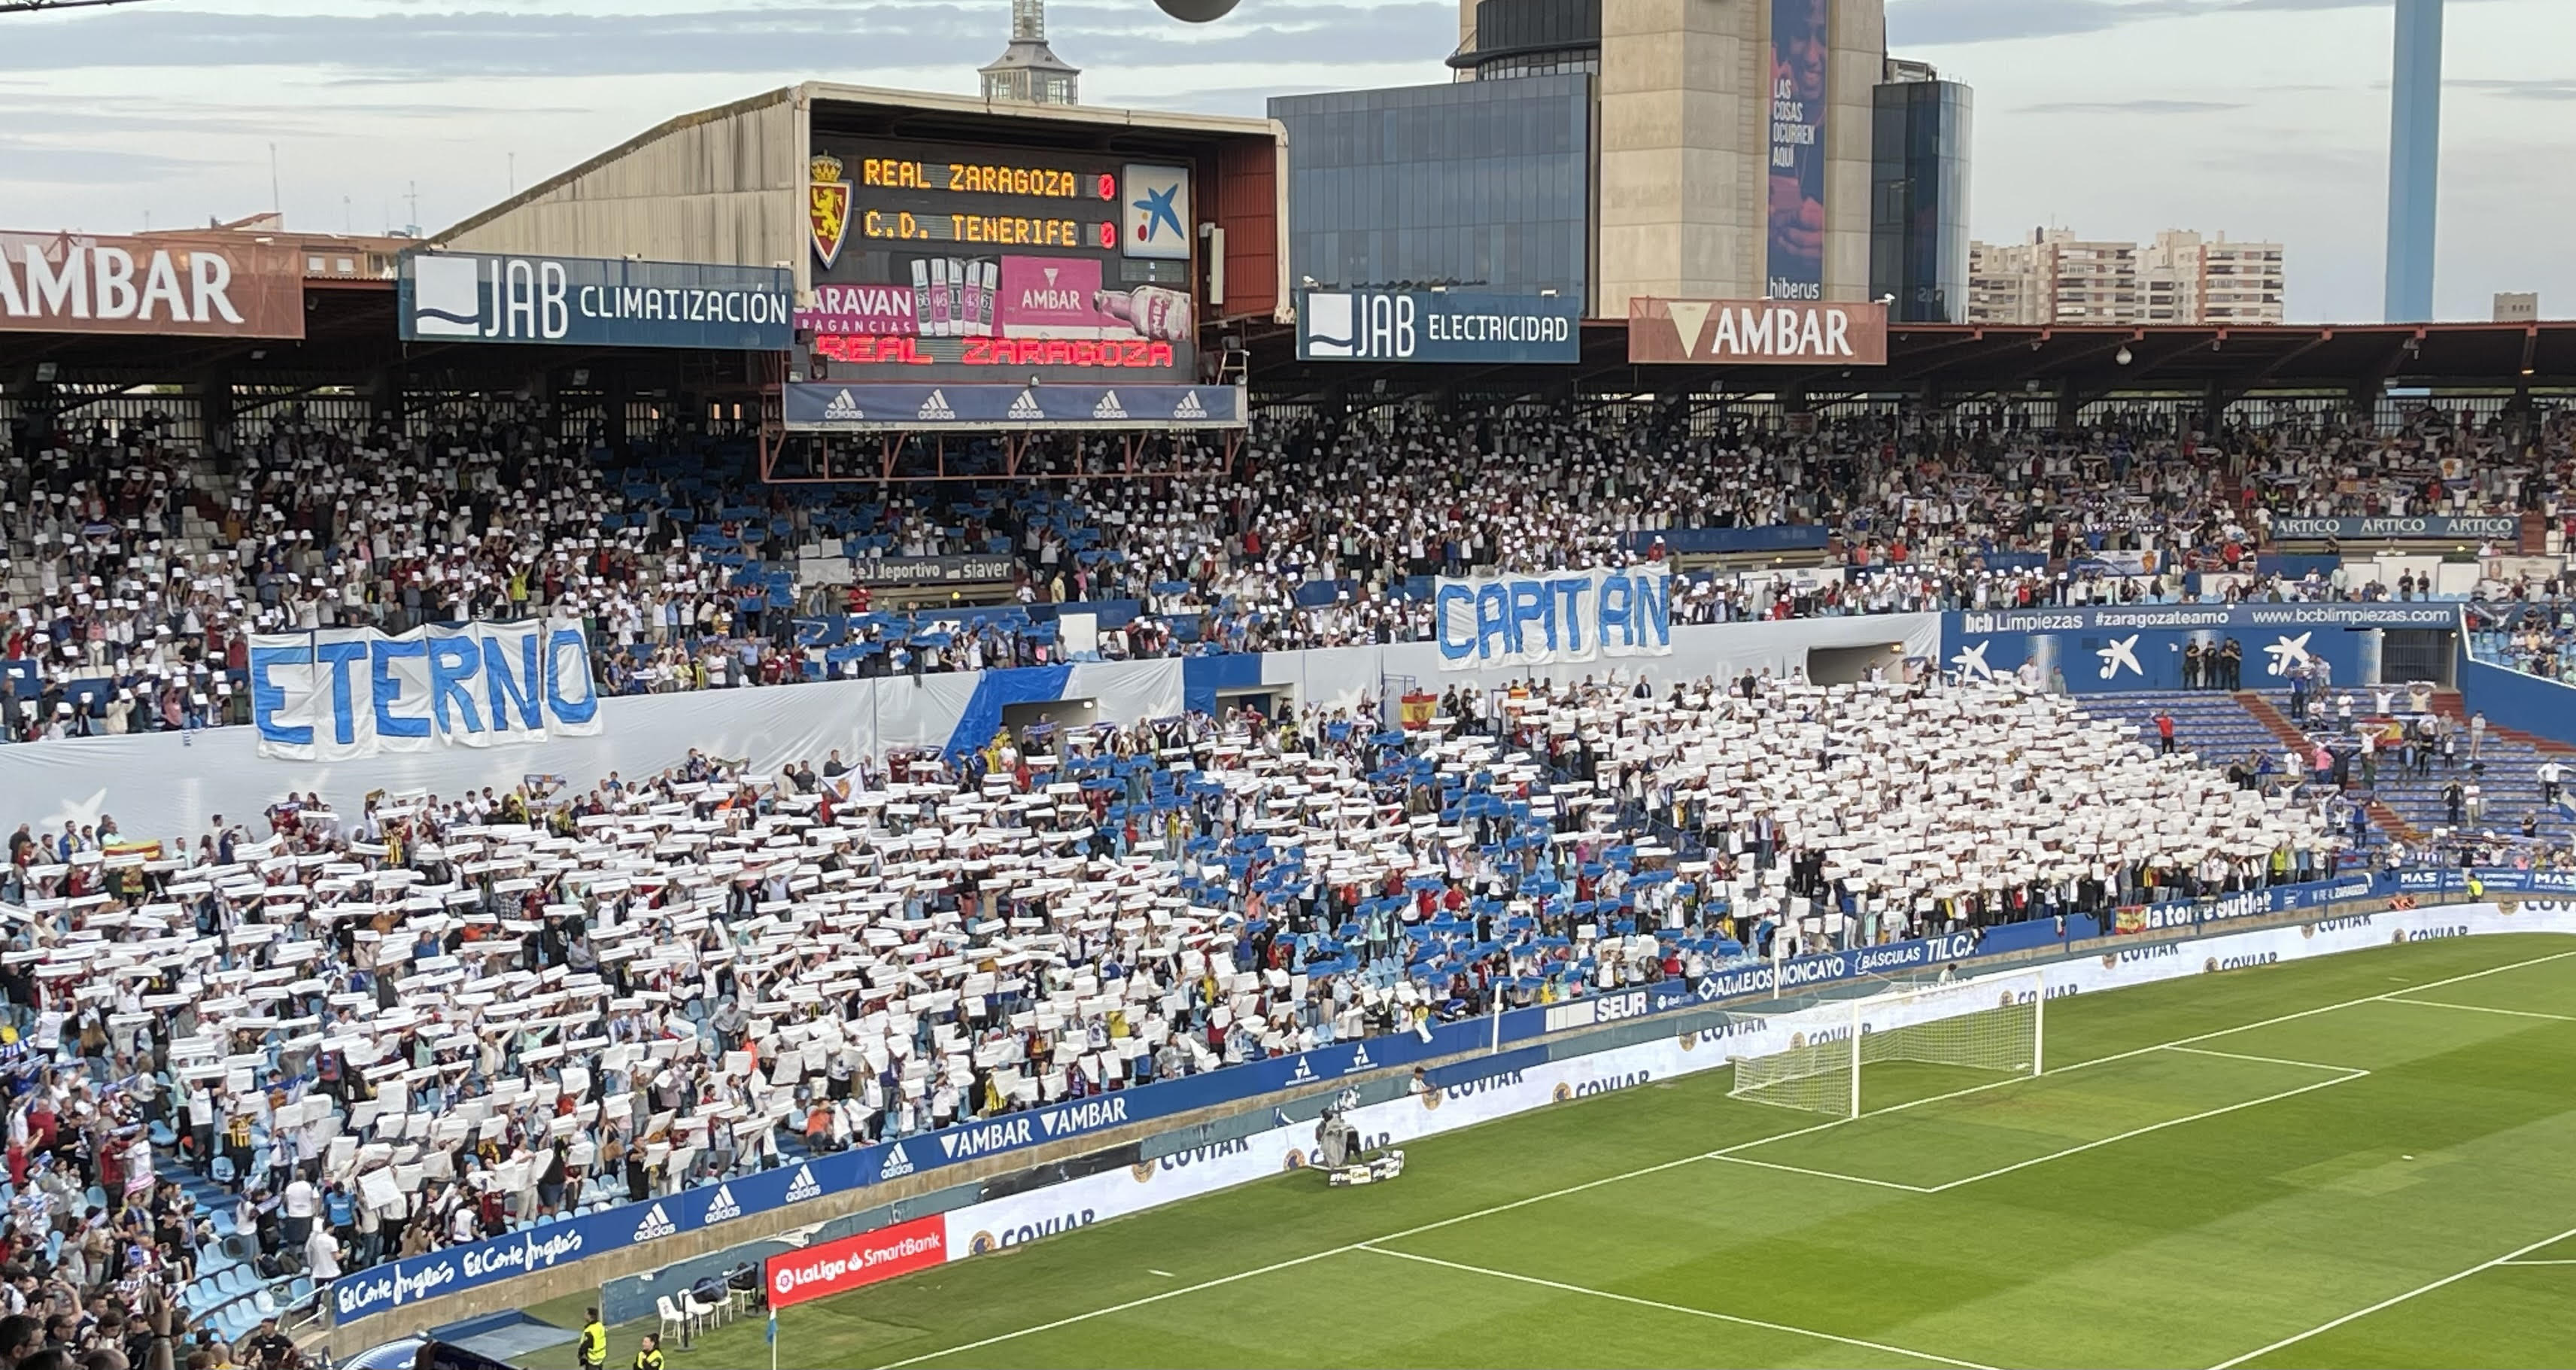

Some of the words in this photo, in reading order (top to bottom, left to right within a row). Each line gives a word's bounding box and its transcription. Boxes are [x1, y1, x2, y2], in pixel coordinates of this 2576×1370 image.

[1774, 79, 1791, 100] LAS
[1773, 102, 1803, 122] COSAS
[1773, 123, 1815, 145] OCURREN
[1773, 144, 1794, 168] AQUÍ
[863, 159, 931, 189] REAL
[948, 163, 1076, 198] ZARAGOZA
[1098, 174, 1115, 201] 0
[864, 210, 929, 240] C.D.
[951, 214, 1077, 246] TENERIFE
[1099, 222, 1117, 249] 0
[485, 259, 569, 339] JAB
[579, 284, 787, 324] CLIMATIZACIÓN
[1769, 275, 1819, 299] hiberus
[793, 287, 912, 317] ARAVAN
[1022, 289, 1082, 311] AMBAR
[1357, 293, 1414, 358] JAB
[1428, 313, 1569, 342] ELECTRICIDAD
[1711, 306, 1854, 357] AMBAR
[816, 335, 934, 365] REAL
[961, 336, 1174, 367] ZARAGOZA
[825, 409, 864, 420] adidas
[918, 409, 955, 420] adidas
[1008, 409, 1044, 419] adidas
[1092, 409, 1129, 419] adidas
[1173, 409, 1208, 418] adidas
[963, 558, 1011, 579] siaver
[1437, 567, 1670, 661] CAPITÁN
[1965, 612, 1993, 633] bcb
[1996, 612, 2084, 633] Limpiezas
[2095, 611, 2229, 629] #zaragozateamo
[2252, 607, 2450, 626] www.bcblimpiezas.com
[251, 629, 598, 745] ETERNO
[2401, 872, 2437, 883] MAS
[2146, 904, 2163, 929] la
[1862, 946, 1921, 970] BÁSCULAS
[1778, 955, 1844, 987] MONCAYO
[1596, 992, 1647, 1022] SEUR
[957, 1118, 1033, 1158] AMBAR
[1056, 1097, 1128, 1136] AMBAR
[881, 1161, 914, 1180] adidas
[786, 1183, 822, 1203] adidas
[705, 1205, 741, 1224] adidas
[633, 1223, 676, 1242] adidas
[463, 1250, 482, 1277] El
[483, 1244, 524, 1272] Corte
[525, 1229, 583, 1271] Inglés
[794, 1259, 846, 1286] LaLiga
[864, 1232, 941, 1267] SmartBank
[339, 1284, 355, 1314] El
[356, 1278, 392, 1308] Corte
[393, 1261, 454, 1305] Inglés
